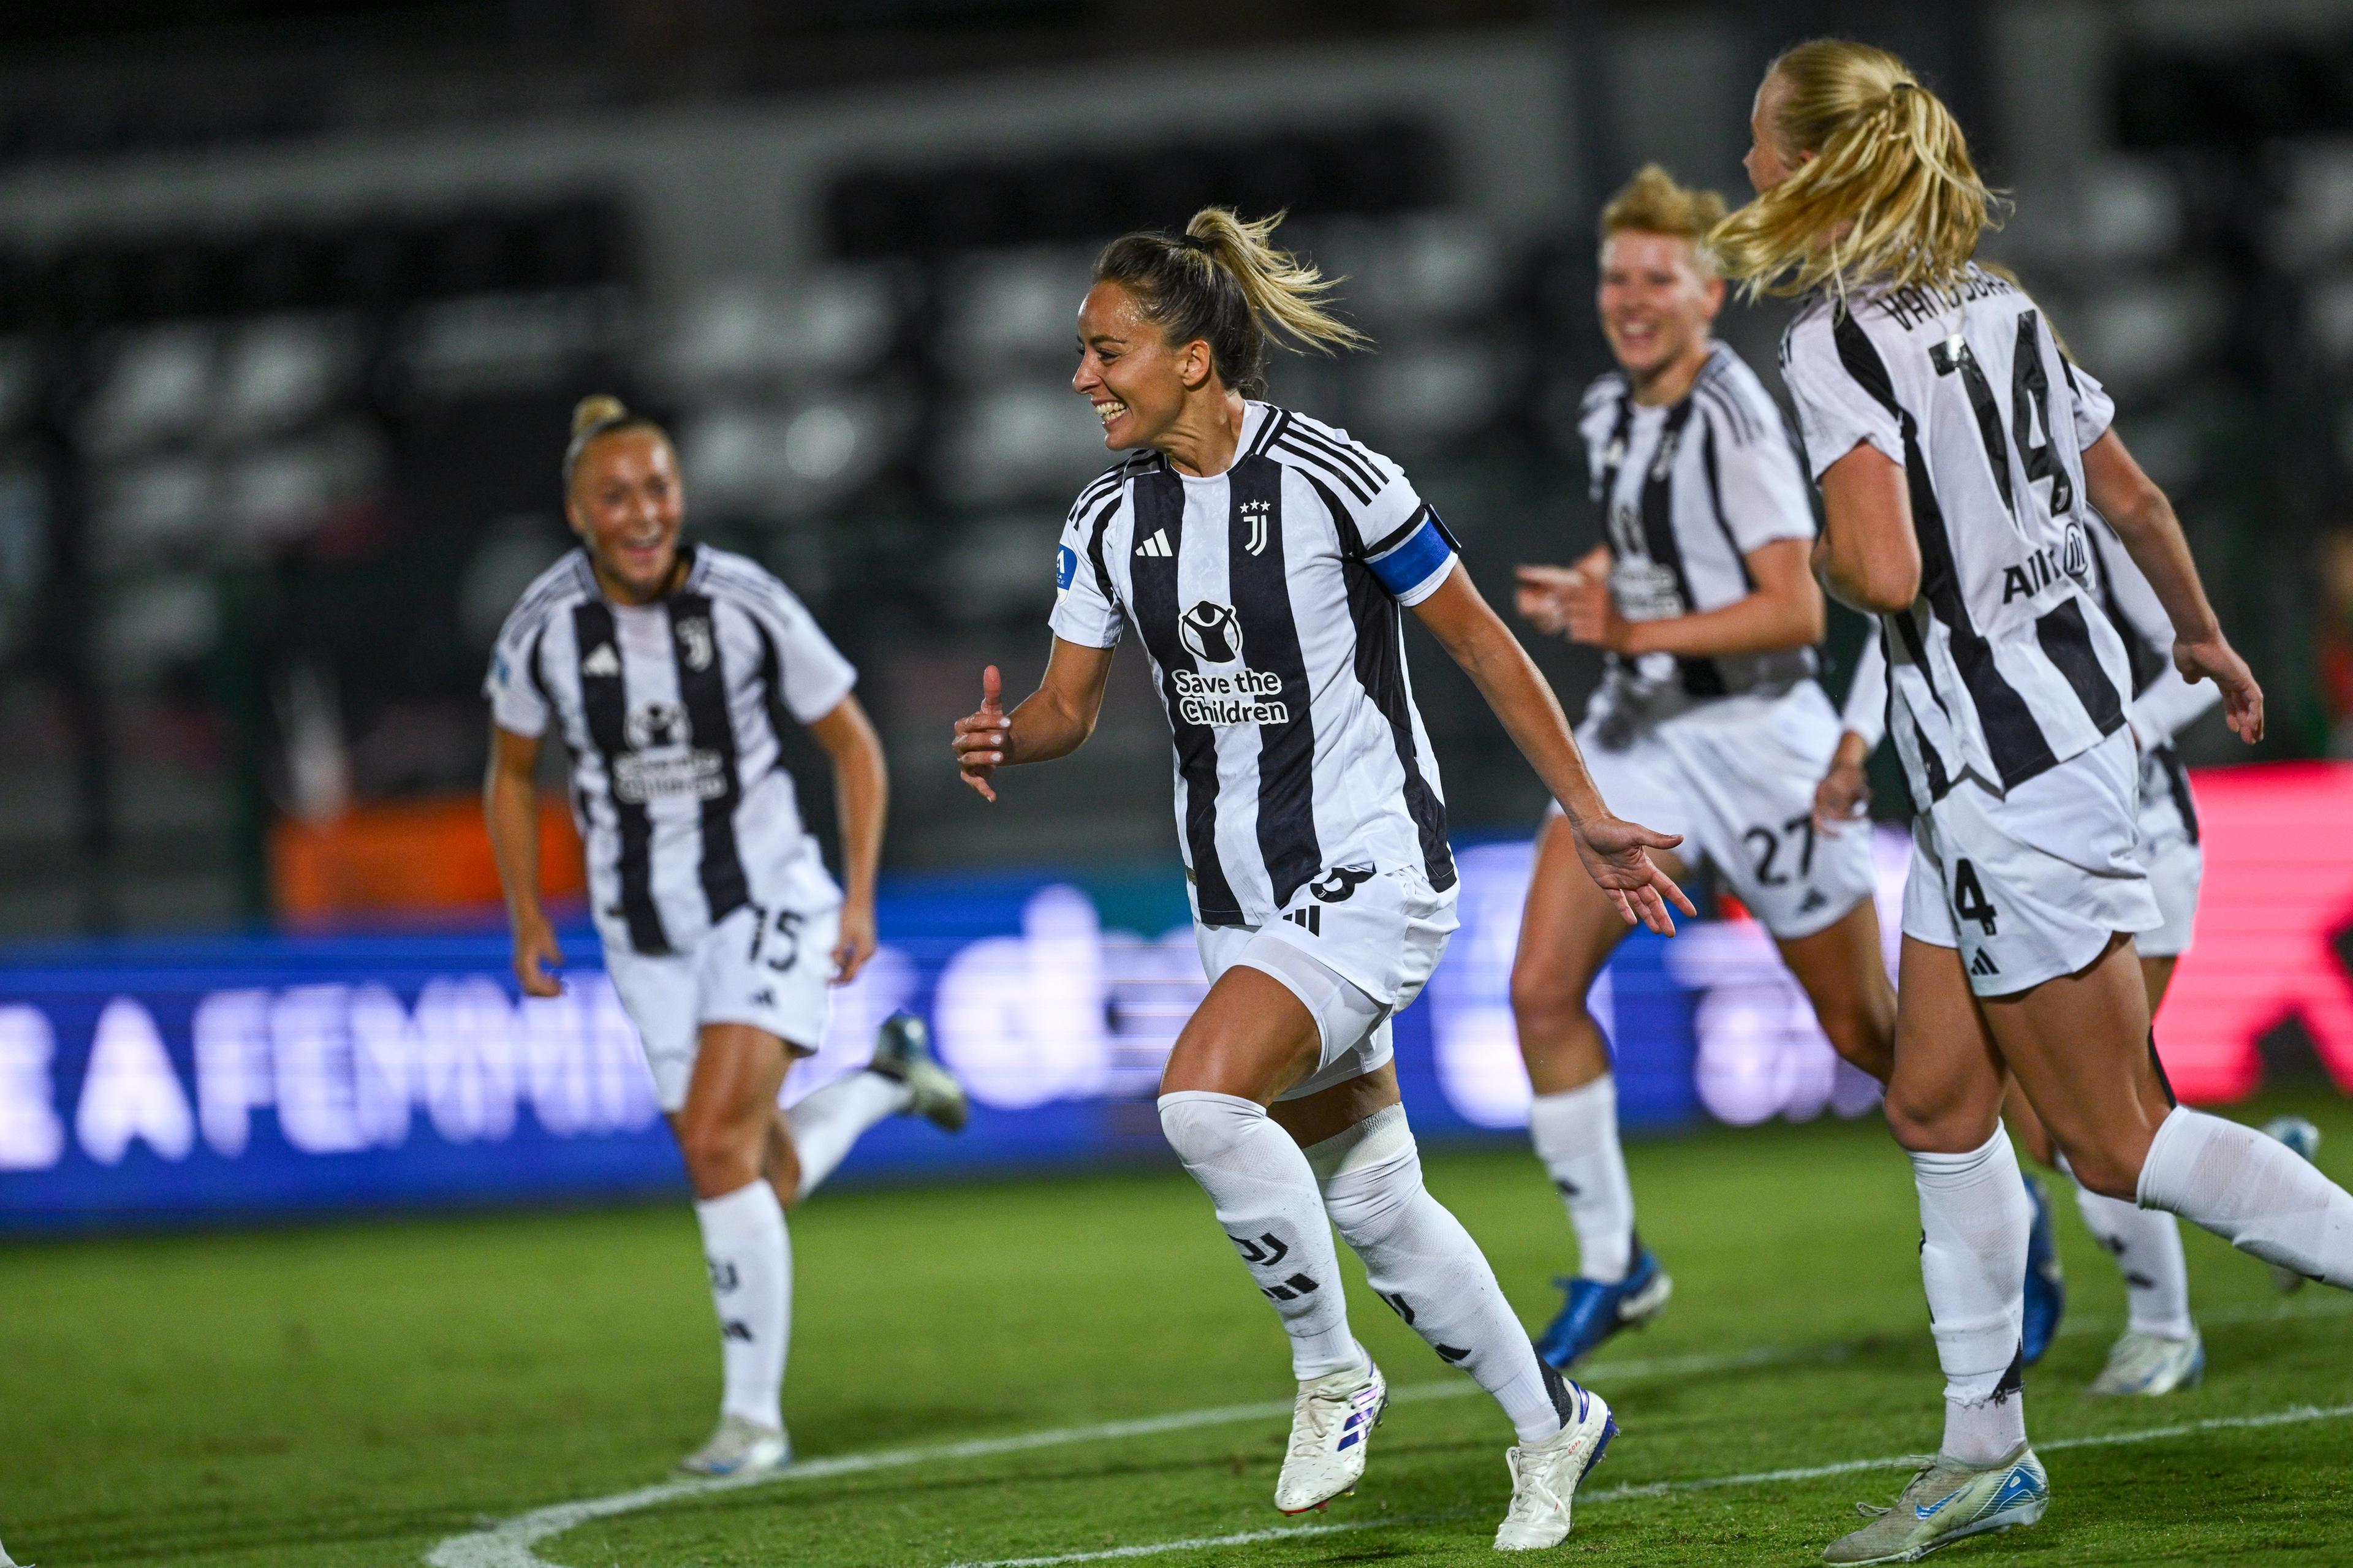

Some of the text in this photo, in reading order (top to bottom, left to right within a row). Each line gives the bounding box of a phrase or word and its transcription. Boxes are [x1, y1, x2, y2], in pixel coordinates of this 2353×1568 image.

[1928, 308, 2073, 528] 14
[1175, 670, 1278, 694] Save the
[1182, 699, 1286, 724] Children
[1742, 813, 1814, 886] 27
[749, 906, 806, 972] 15
